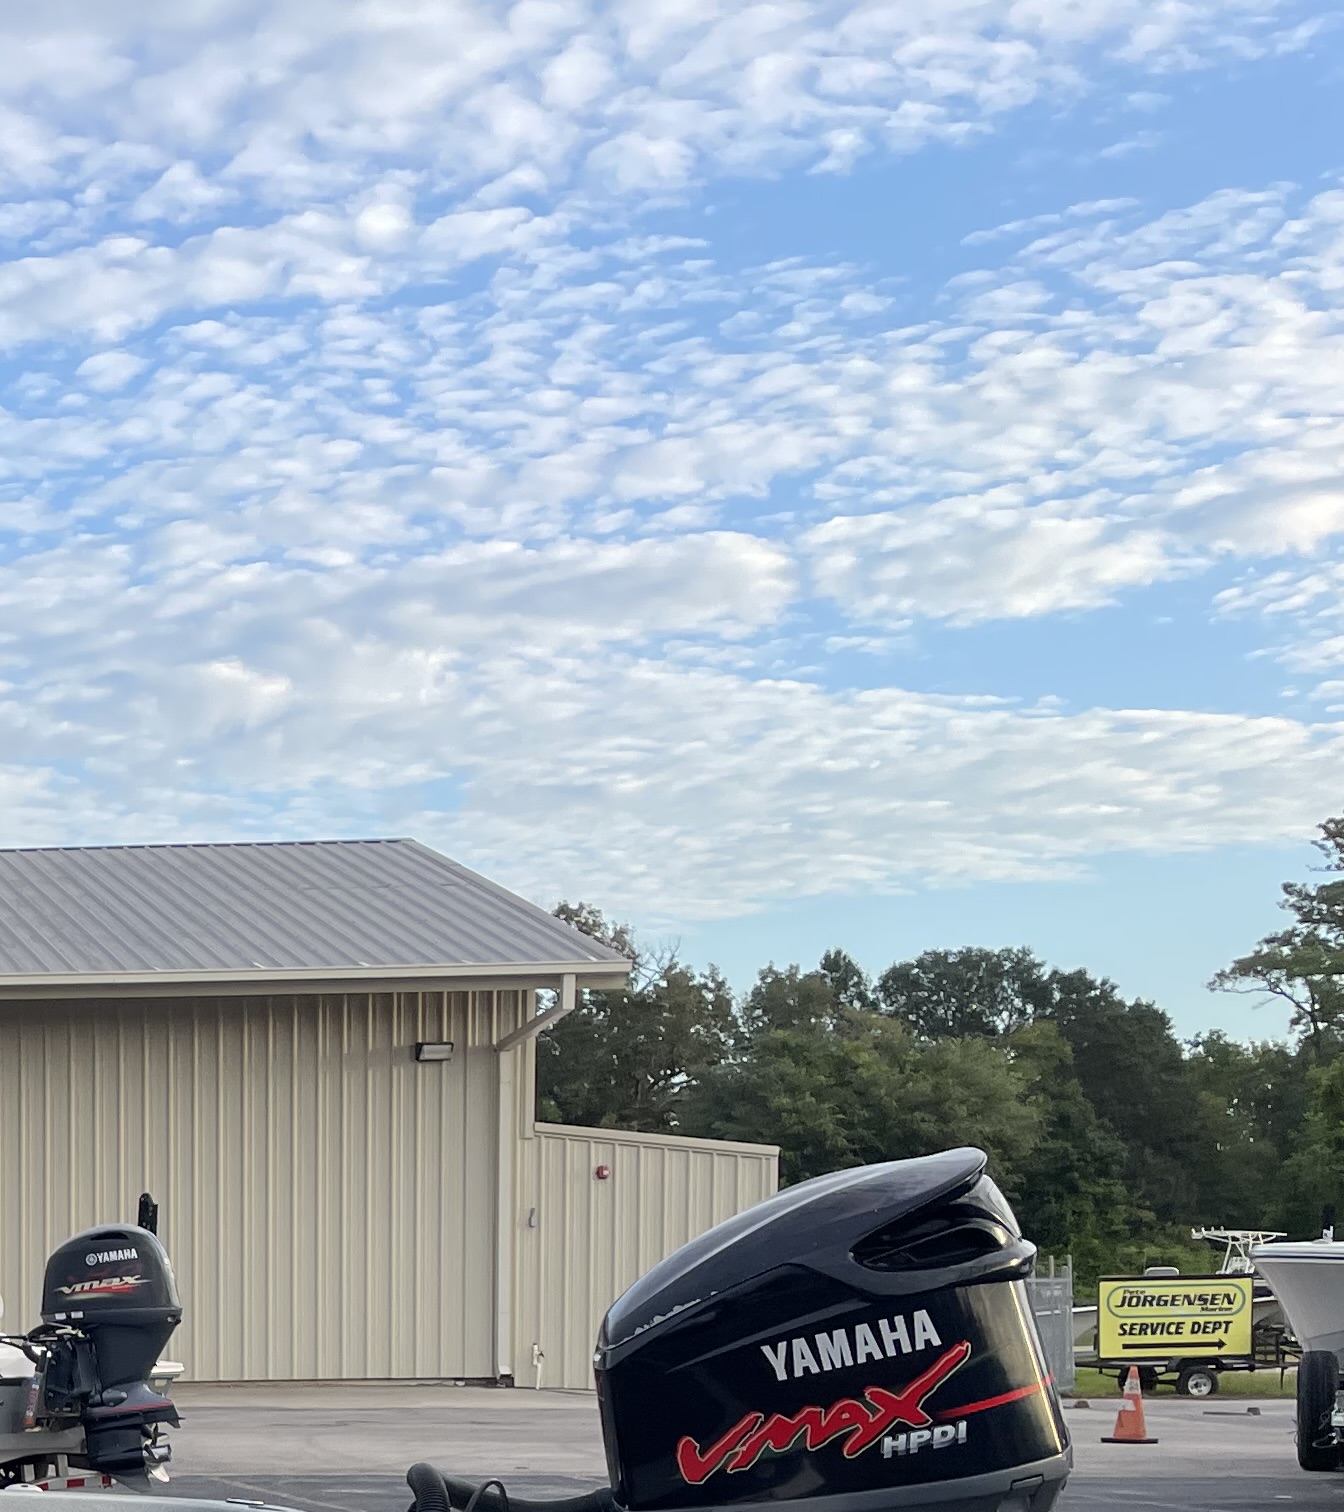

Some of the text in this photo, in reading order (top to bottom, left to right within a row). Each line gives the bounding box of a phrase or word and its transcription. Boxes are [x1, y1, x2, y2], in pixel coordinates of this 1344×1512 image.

[96, 1248, 139, 1263] YAMAHA
[1114, 1292, 1237, 1308] JORGENSEN
[1118, 1320, 1233, 1336] SERVICE DEPT
[760, 1309, 942, 1381] YAMAHA
[881, 1420, 967, 1459] HPDI
